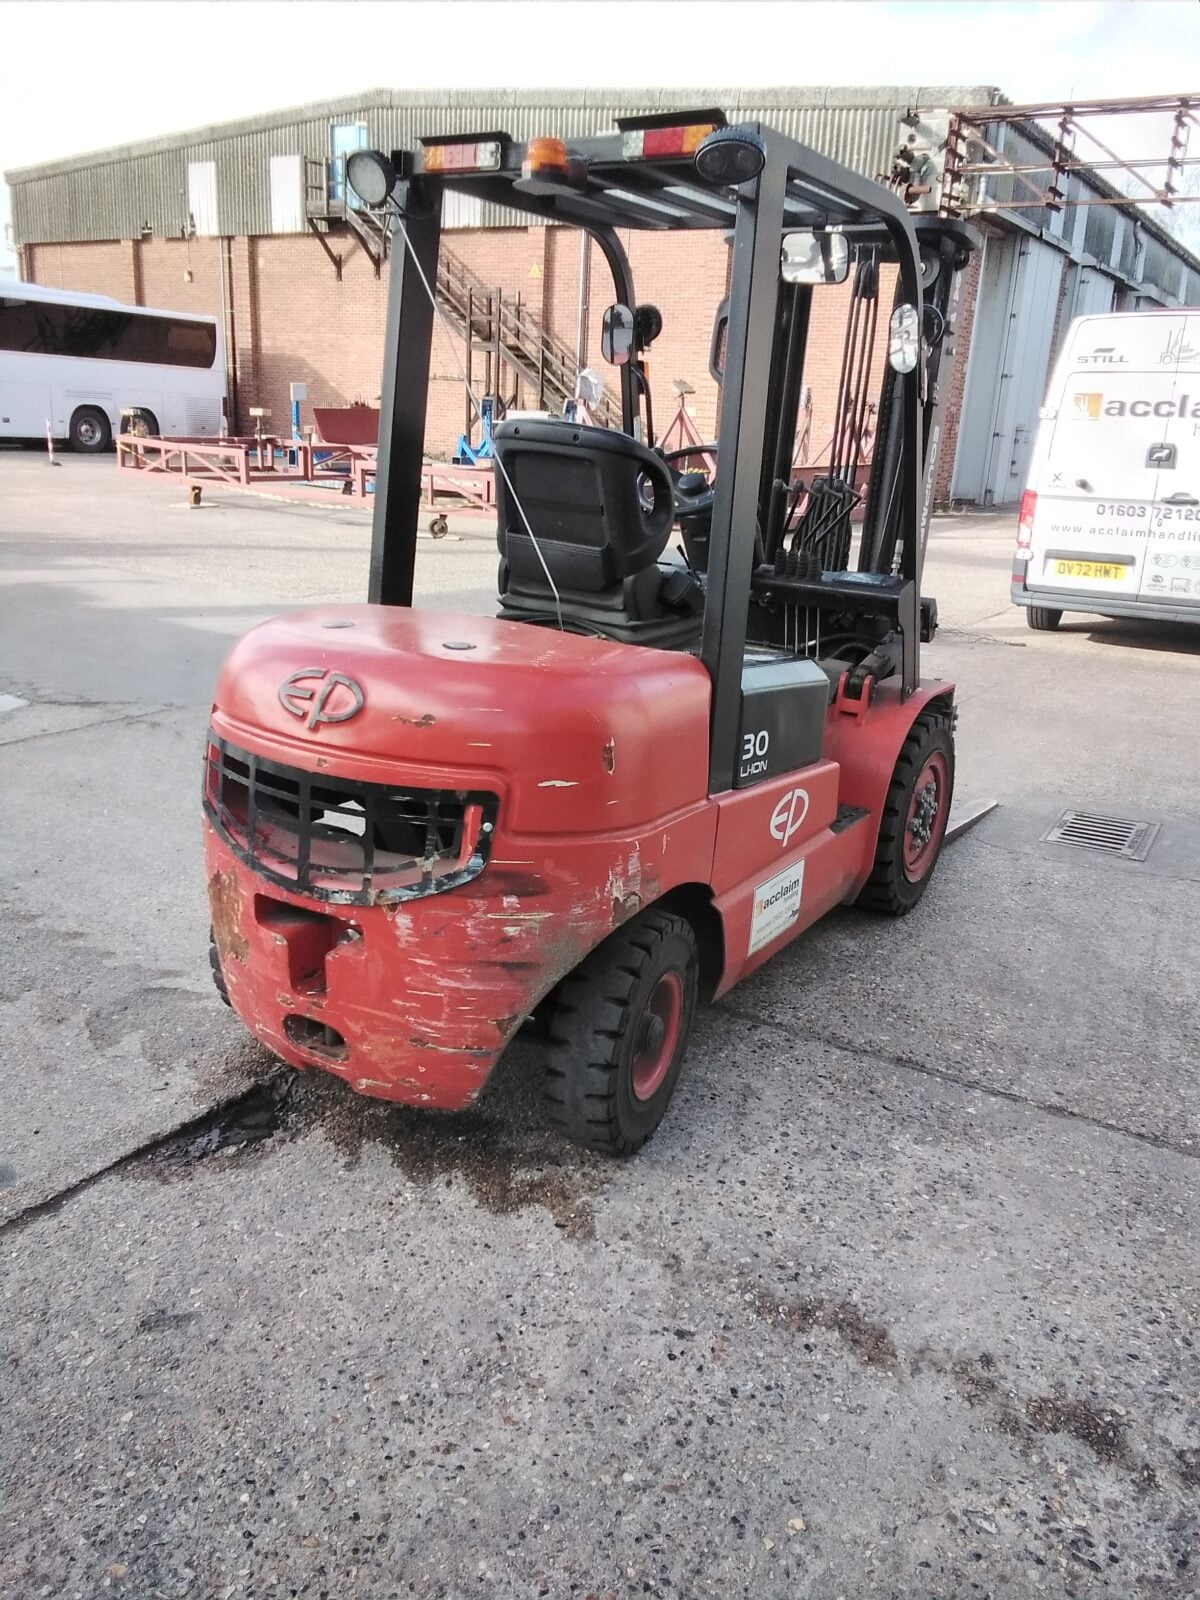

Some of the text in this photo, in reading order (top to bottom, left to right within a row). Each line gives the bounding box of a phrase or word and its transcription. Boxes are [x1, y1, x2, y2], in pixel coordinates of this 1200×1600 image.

[1077, 355, 1129, 364] STILL
[1096, 503, 1147, 518] 01603
[1094, 566, 1121, 579] HWT
[742, 730, 769, 760] 30
[769, 788, 809, 848] EP
[763, 878, 800, 910] acclaim
